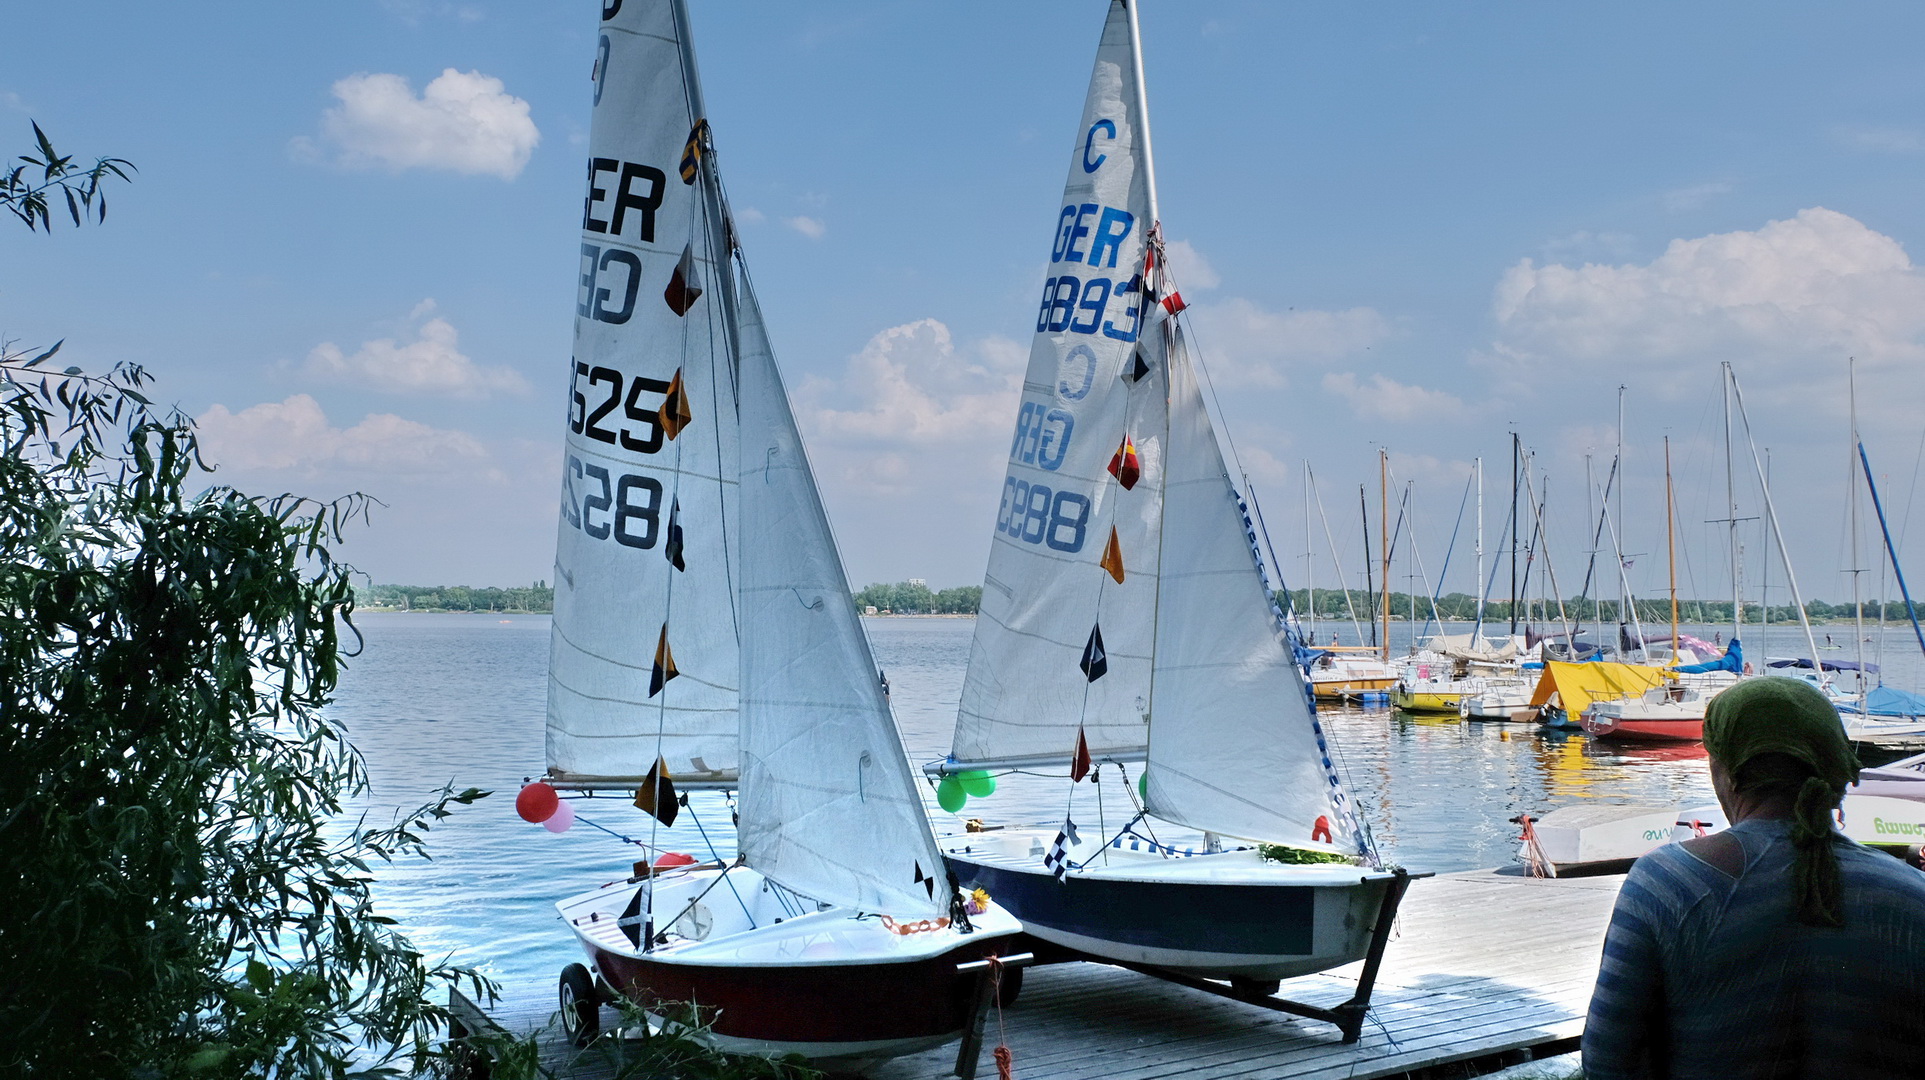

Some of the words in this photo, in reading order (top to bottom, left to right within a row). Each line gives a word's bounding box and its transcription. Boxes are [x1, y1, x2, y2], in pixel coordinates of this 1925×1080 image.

[1083, 119, 1116, 174] C
[582, 157, 666, 243] ER
[1051, 203, 1135, 269] GER
[1873, 816, 1925, 839] ommy
